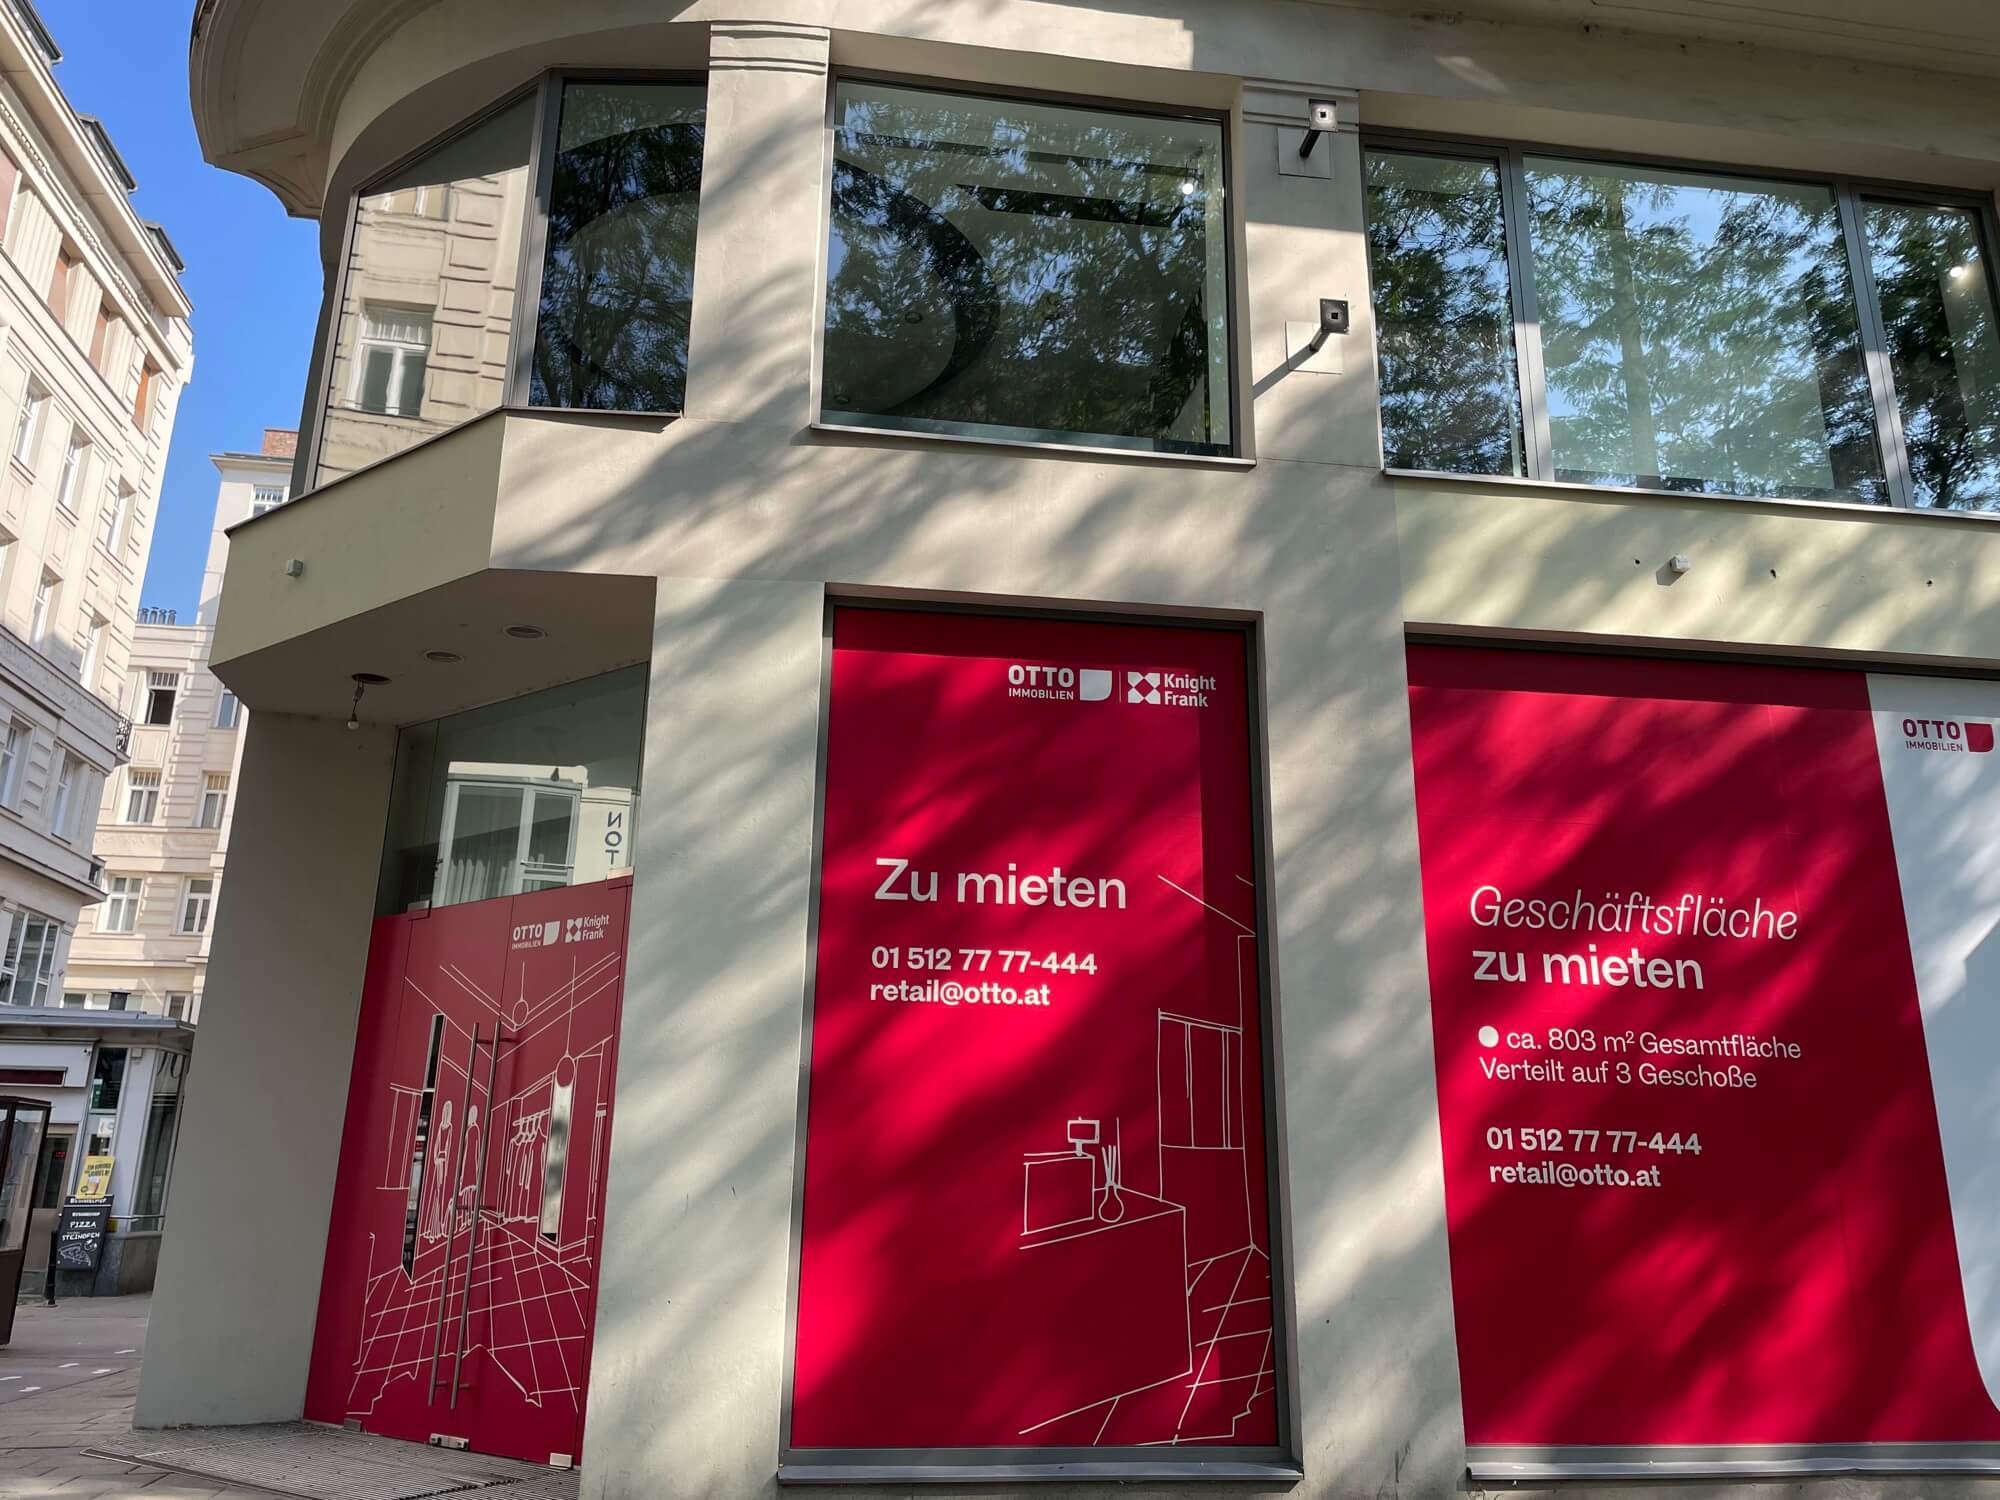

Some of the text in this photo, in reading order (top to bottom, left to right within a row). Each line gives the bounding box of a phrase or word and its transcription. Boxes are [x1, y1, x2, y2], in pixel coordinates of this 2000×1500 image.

[1009, 665, 1074, 687] OTTO
[1164, 673, 1216, 692] Knight
[1009, 686, 1073, 700] IMMOBILIEN
[1165, 689, 1208, 707] Frank
[1902, 718, 1960, 740] OTTO
[1905, 740, 1963, 752] IMMOBILIEN
[875, 858, 1126, 908] Zu mieten
[583, 914, 609, 928] Knight
[1470, 885, 1797, 940] Geschäftsfläche
[512, 923, 542, 941] OTTO
[582, 928, 604, 940] Frank
[511, 940, 541, 949] IMMOBILIEN
[872, 946, 1097, 975] 01 512 77 77-444
[1473, 944, 1703, 989] zu mieten
[871, 979, 1050, 1006] retail@otto.at
[1507, 1032, 1541, 1049] ca.
[1549, 1028, 1596, 1051] 803
[1640, 1032, 1800, 1058] Gesamtfläche
[1479, 1057, 1756, 1088] Verteilt auf 3 Geschoße
[1487, 1127, 1701, 1155] 01 512 77 77-444
[1490, 1161, 1661, 1187] retail@otto.at
[70, 1221, 97, 1229] PIZZA
